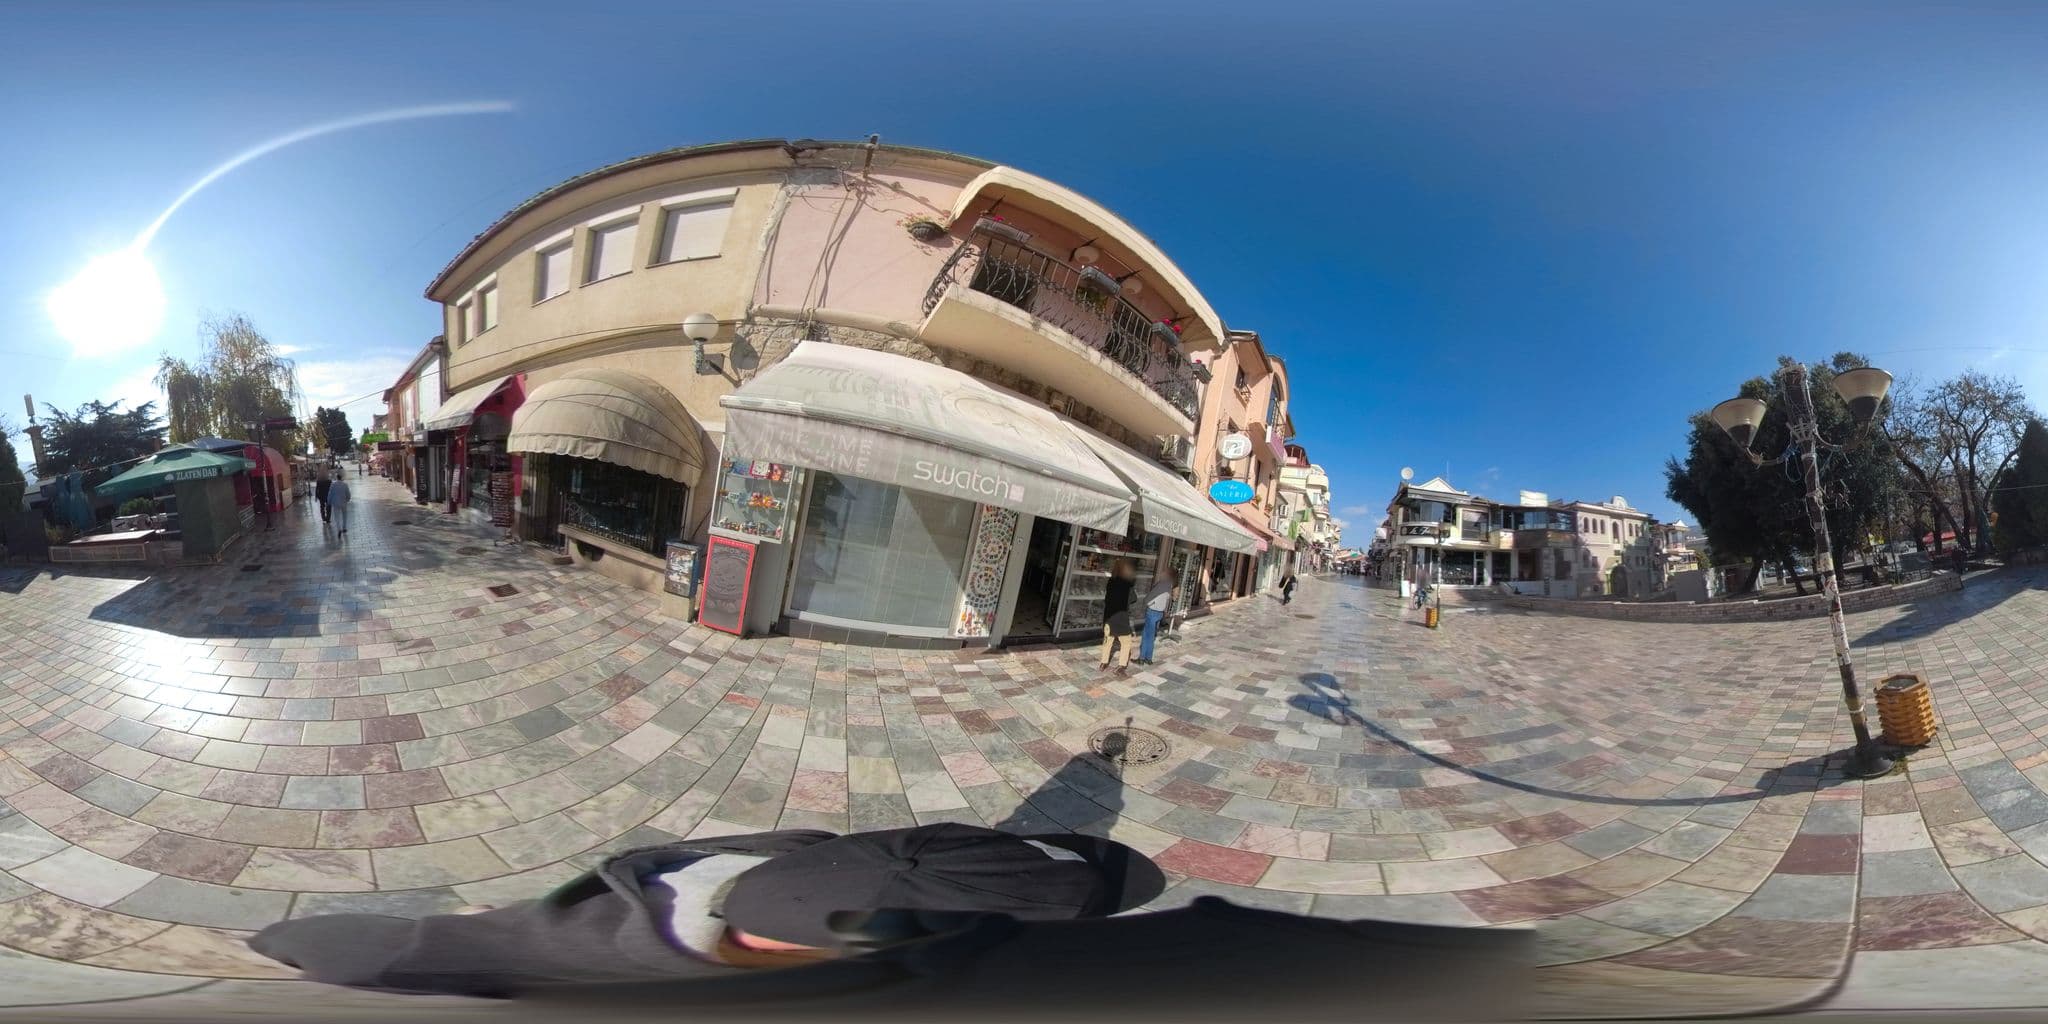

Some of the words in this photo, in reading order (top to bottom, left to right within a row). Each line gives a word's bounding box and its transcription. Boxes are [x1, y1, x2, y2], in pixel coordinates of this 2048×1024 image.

[818, 431, 873, 456] TIME
[176, 469, 201, 481] ZLATEN
[202, 467, 218, 479] DAB
[913, 460, 1009, 499] swatch
[1150, 515, 1184, 534] swatch
